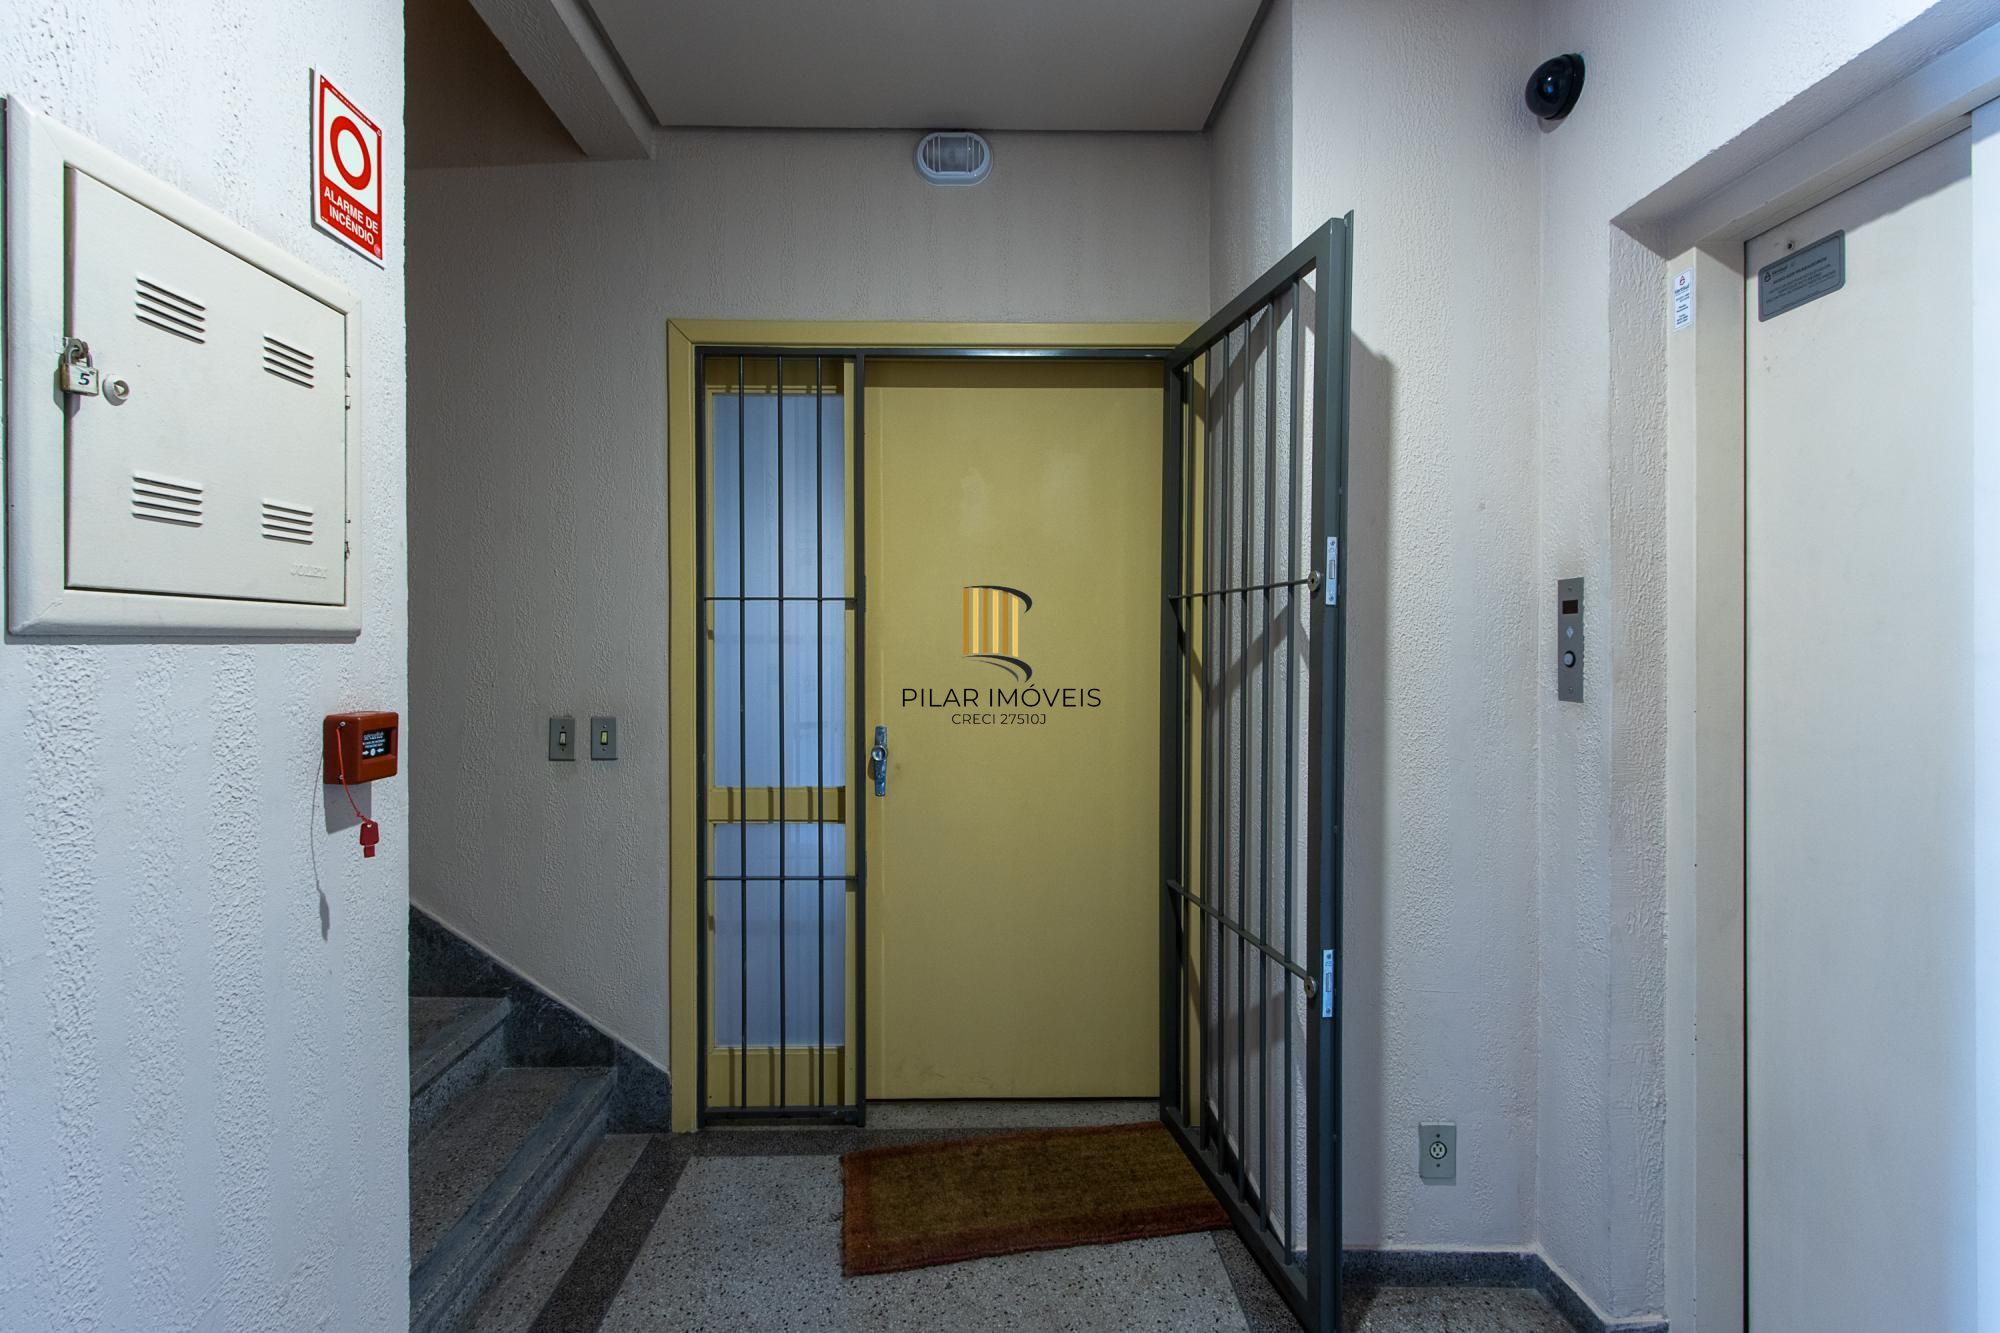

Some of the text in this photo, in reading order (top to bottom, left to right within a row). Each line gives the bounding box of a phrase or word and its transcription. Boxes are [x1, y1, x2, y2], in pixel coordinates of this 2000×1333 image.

[324, 186, 379, 235] ALARME DE
[329, 204, 374, 245] INCÊNDIO
[78, 372, 90, 385] 5
